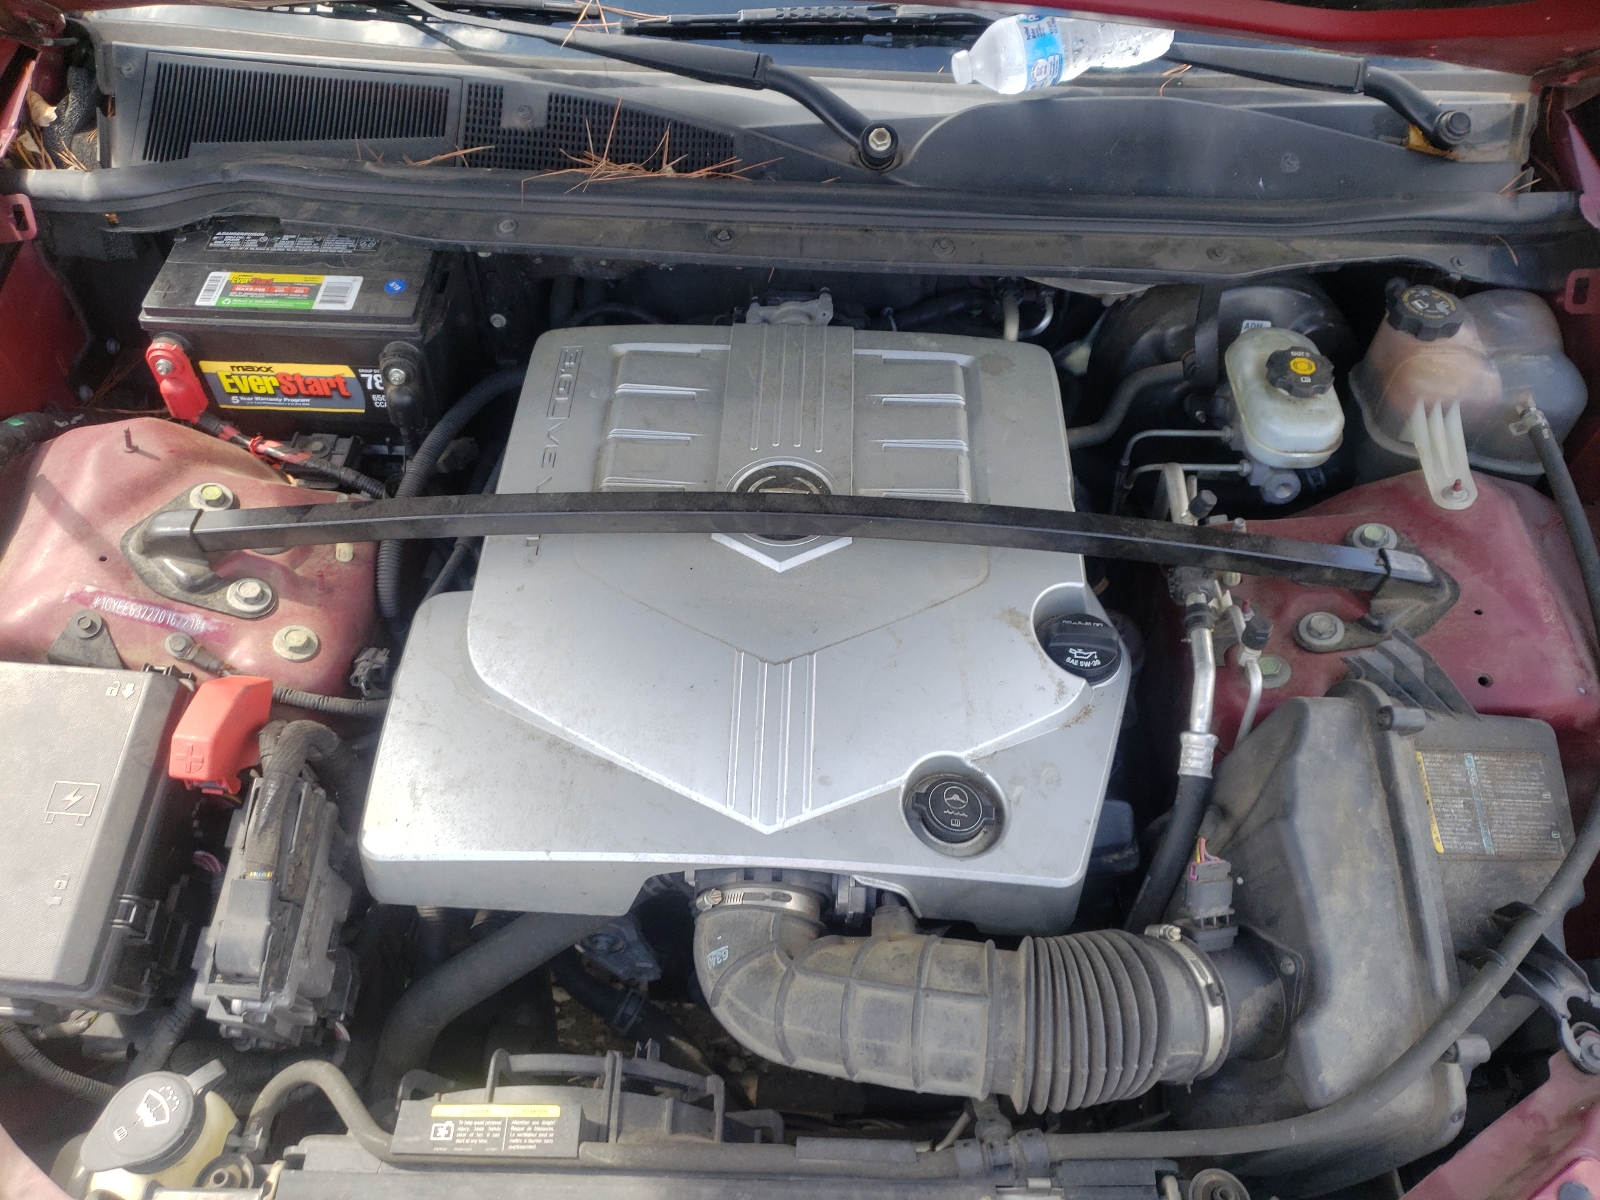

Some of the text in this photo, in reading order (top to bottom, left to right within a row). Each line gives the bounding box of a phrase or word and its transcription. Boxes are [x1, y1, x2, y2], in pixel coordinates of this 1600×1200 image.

[230, 365, 275, 373] maxx
[217, 369, 351, 398] EverStart
[231, 395, 240, 404] 5
[254, 396, 282, 404] Warranty
[1065, 657, 1078, 666] SAE
